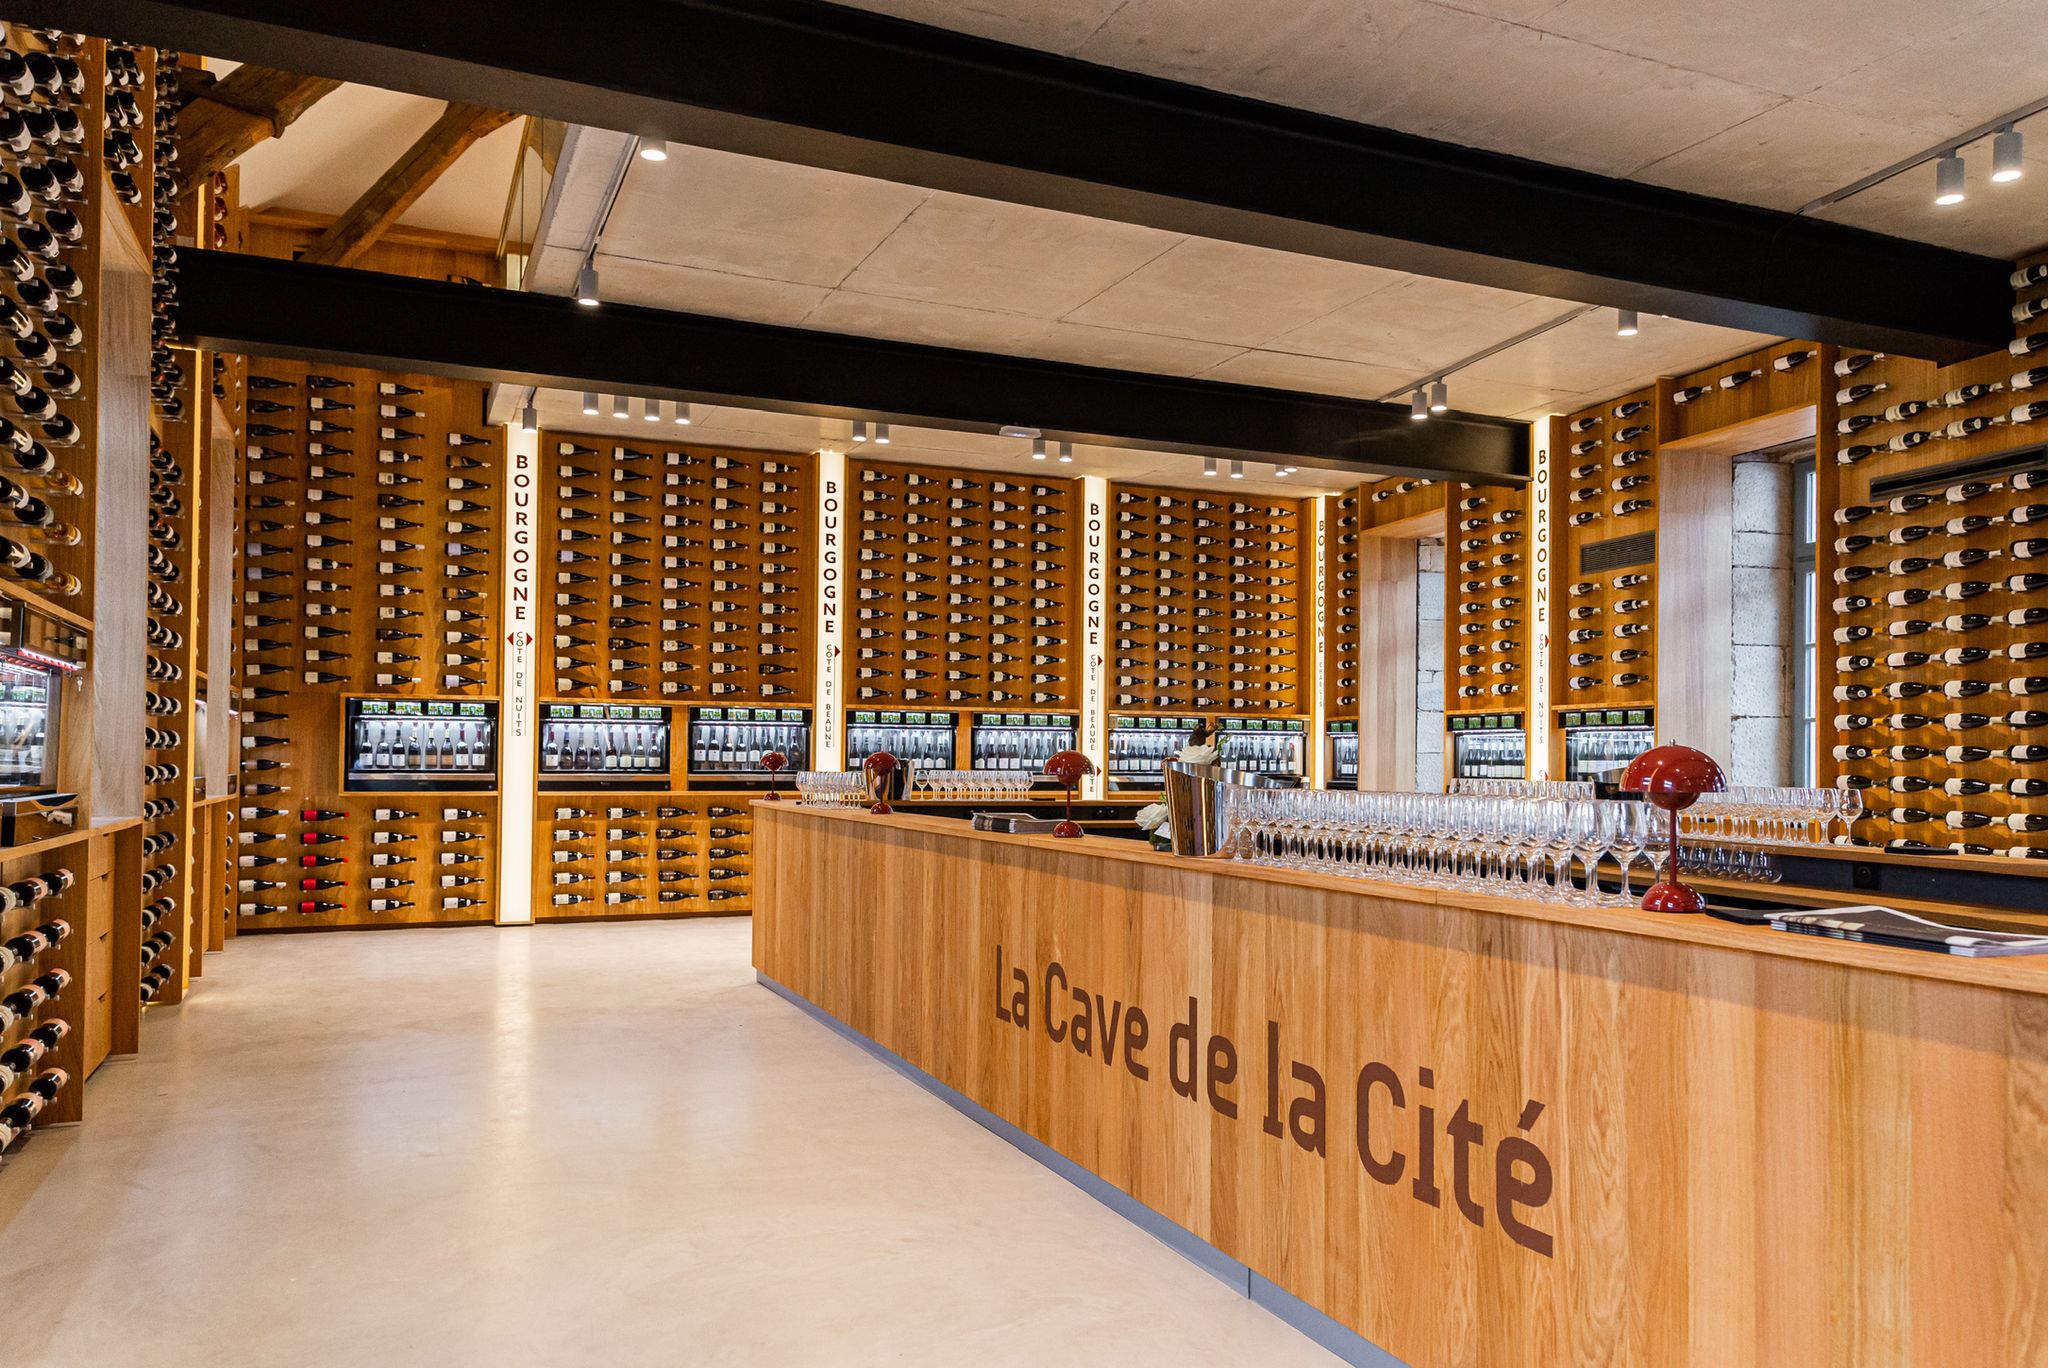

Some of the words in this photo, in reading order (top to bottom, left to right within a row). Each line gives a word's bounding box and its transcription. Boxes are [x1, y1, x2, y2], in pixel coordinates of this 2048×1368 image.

[513, 454, 530, 620] BOURGOGNE
[823, 481, 838, 633] BOURGOGNE
[1088, 503, 1101, 645] BOURGOGNE
[1317, 520, 1325, 653] BOURGOGNE
[1537, 449, 1547, 622] BOURGOGNE
[515, 697, 523, 736] NUITS
[516, 672, 523, 687] DE
[824, 704, 832, 748] BEAUNE
[825, 681, 832, 695] DE
[996, 944, 1030, 1031] La
[1044, 962, 1149, 1082] Cave
[1169, 996, 1238, 1120] de
[1262, 1020, 1327, 1159] la
[1356, 1061, 1553, 1259] Cité
